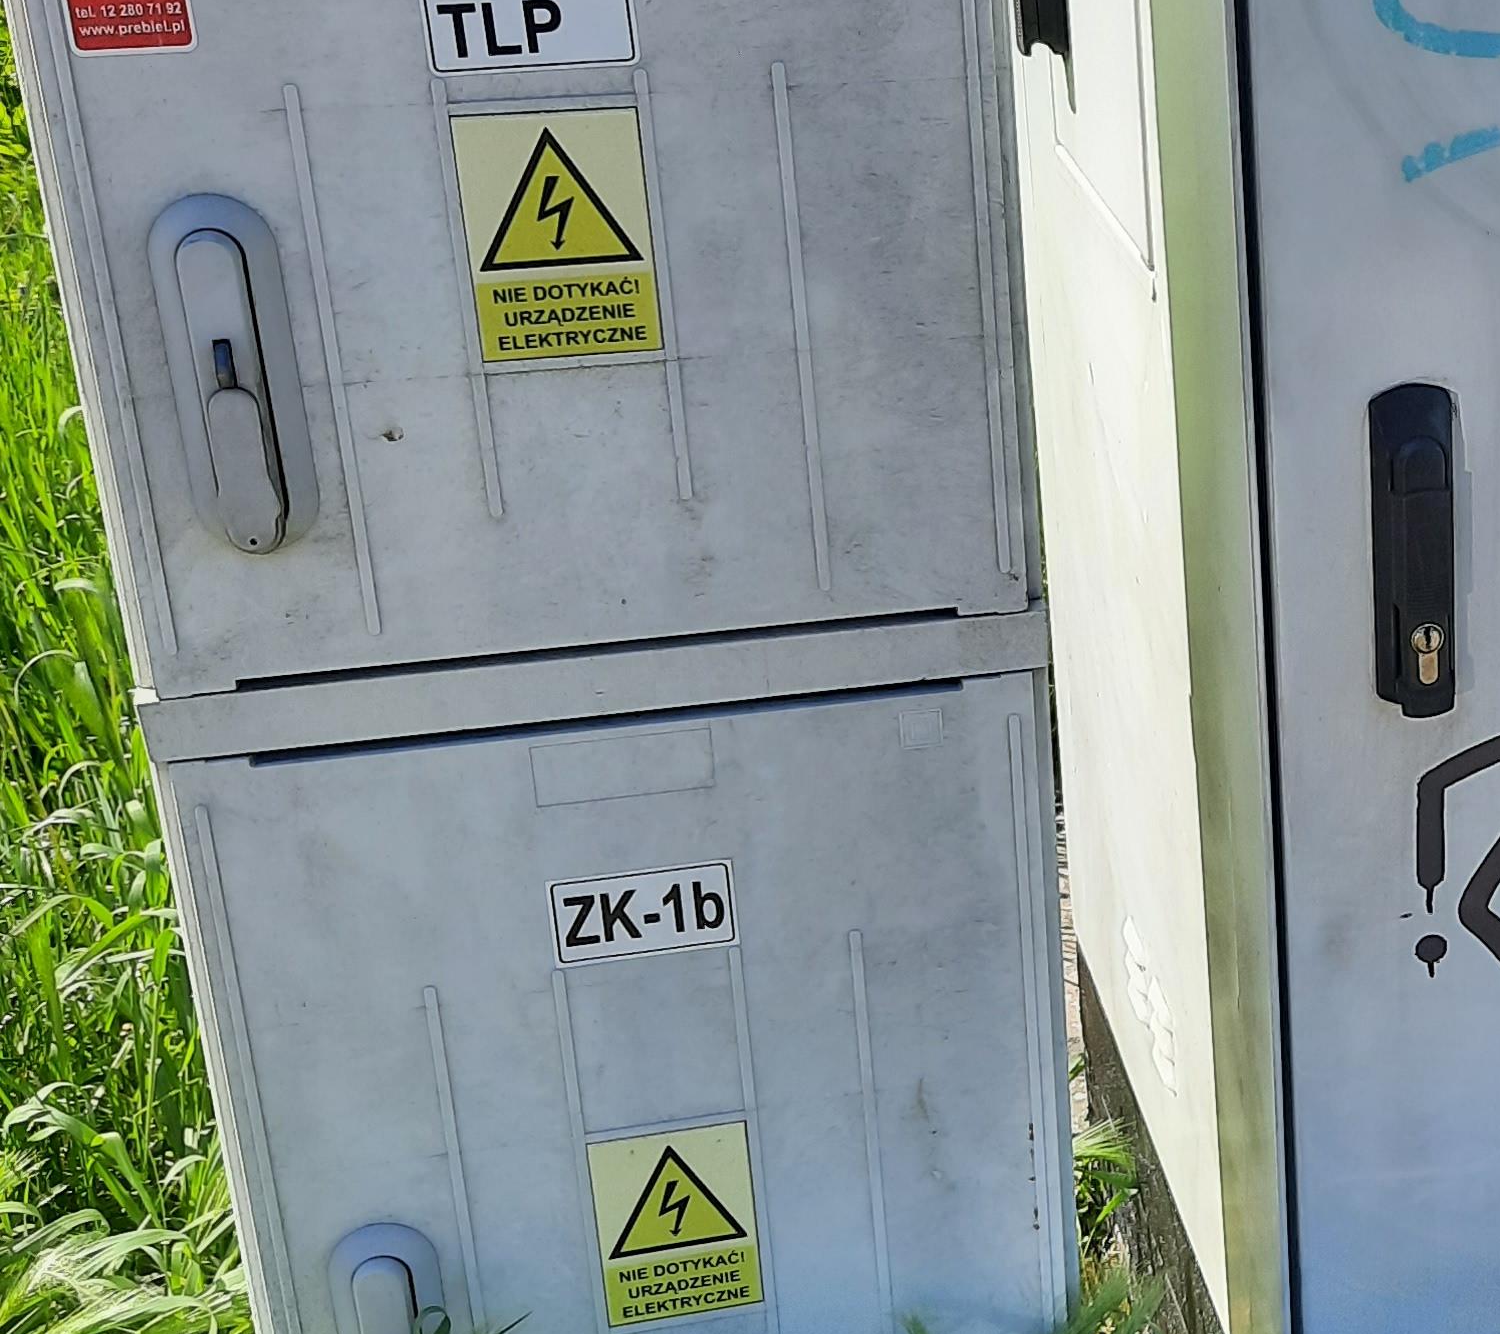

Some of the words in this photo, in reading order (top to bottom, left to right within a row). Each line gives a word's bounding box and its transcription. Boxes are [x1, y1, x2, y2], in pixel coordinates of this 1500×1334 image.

[100, 5, 116, 18] 12
[119, 3, 143, 16] 280
[146, 2, 162, 15] 71
[165, 1, 182, 15] 92
[78, 19, 186, 37] www.prebiel.pl
[436, 0, 562, 58] TLP
[492, 285, 528, 304] NIE
[533, 276, 640, 302] DOTYKAĆ!
[504, 303, 636, 327] URZĄDZENIE
[498, 325, 648, 351] ELEKTRYCZNE
[562, 881, 725, 948] ZK-1b
[619, 1267, 649, 1283] NIE
[653, 1250, 745, 1278] DOTYKAĆ!
[628, 1270, 741, 1299] URZĄDZENIE
[622, 1286, 750, 1319] ELEKTRYCZNE
